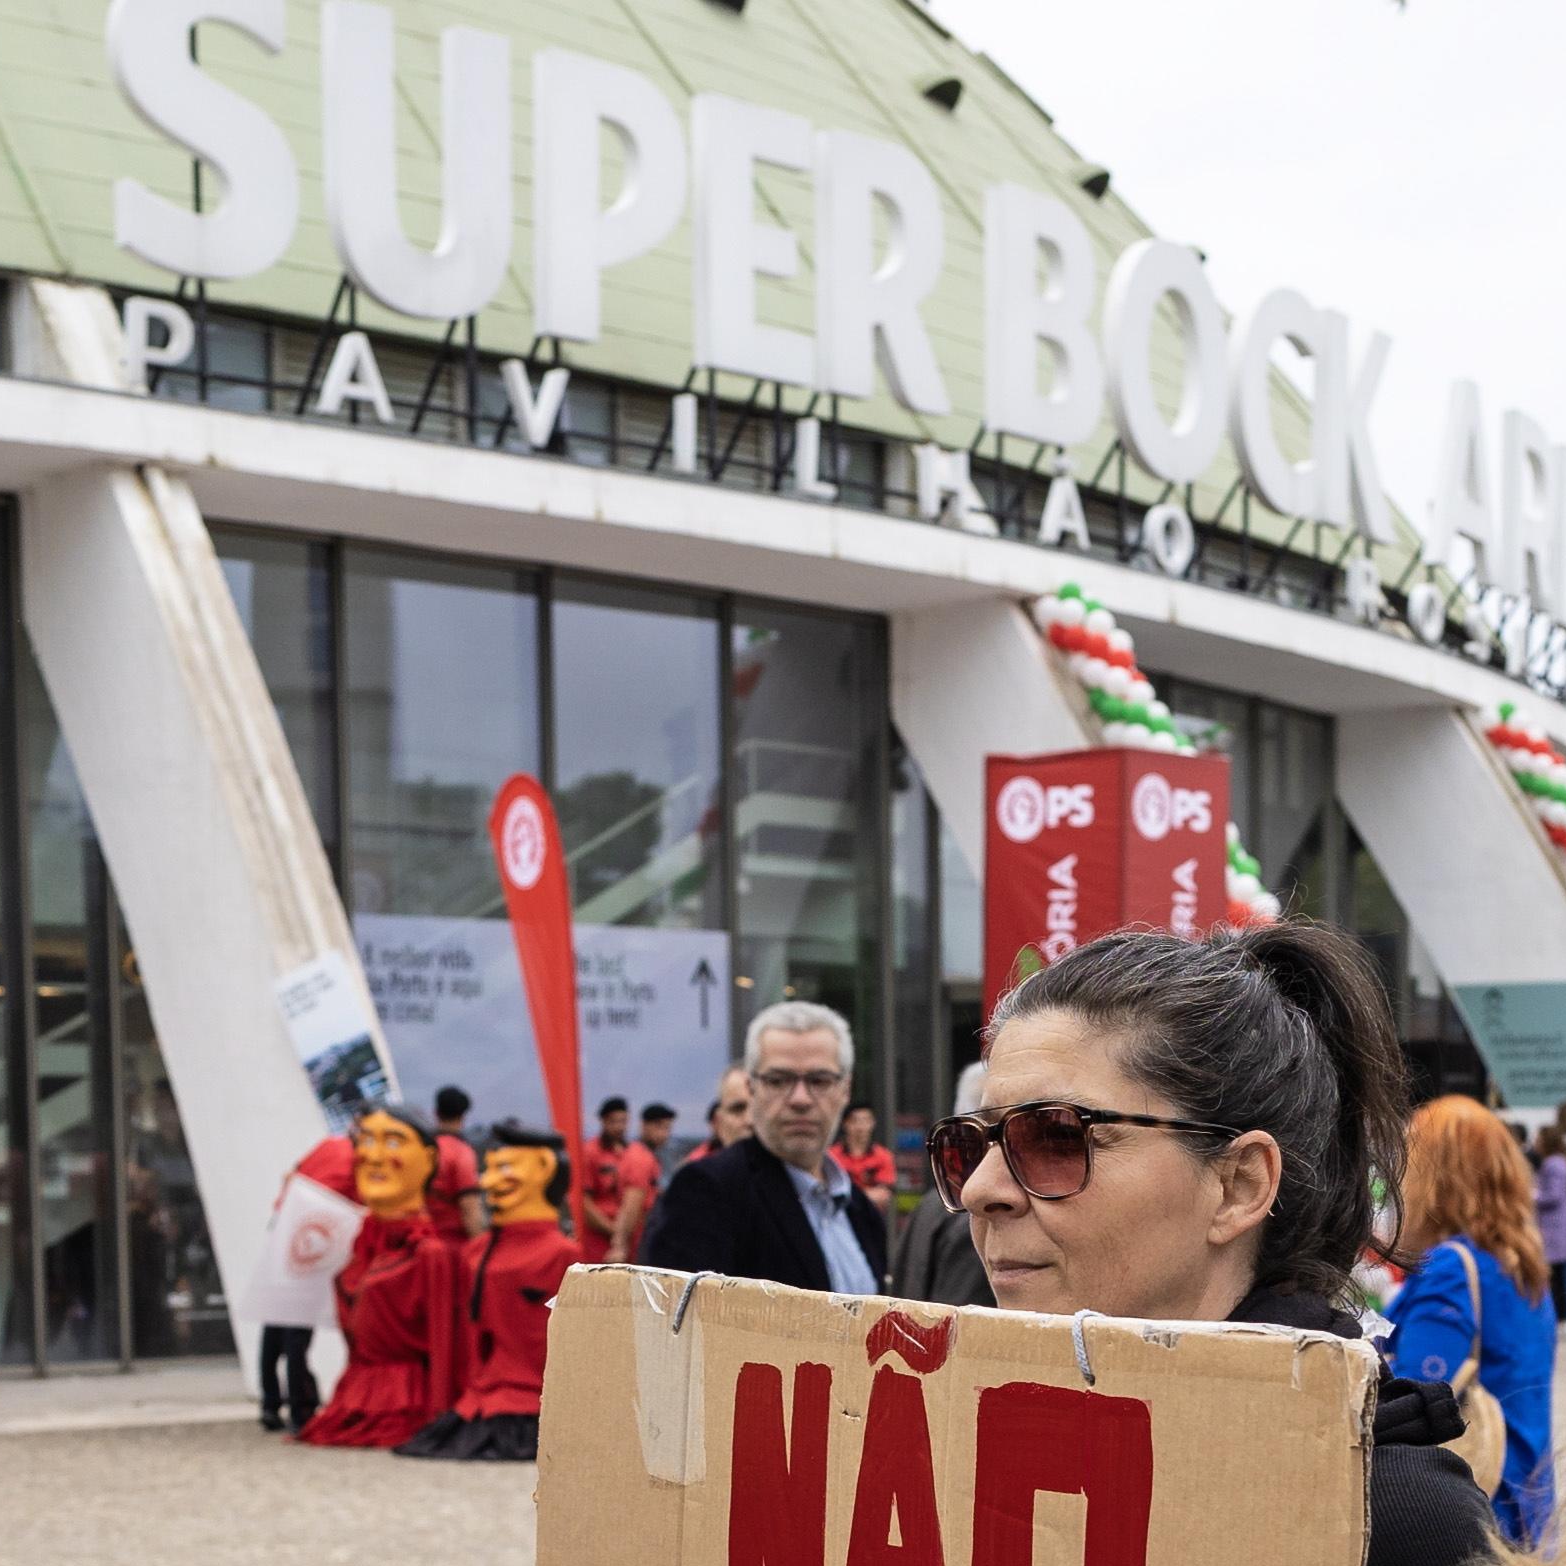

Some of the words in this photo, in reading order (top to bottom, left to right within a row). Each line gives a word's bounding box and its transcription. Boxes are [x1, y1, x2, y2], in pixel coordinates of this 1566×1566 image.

[107, 0, 952, 416] SUPER
[982, 182, 1394, 546] BOCK
[1045, 783, 1095, 829] PS
[1171, 787, 1212, 834] PS
[1039, 852, 1079, 964] ÓRIA
